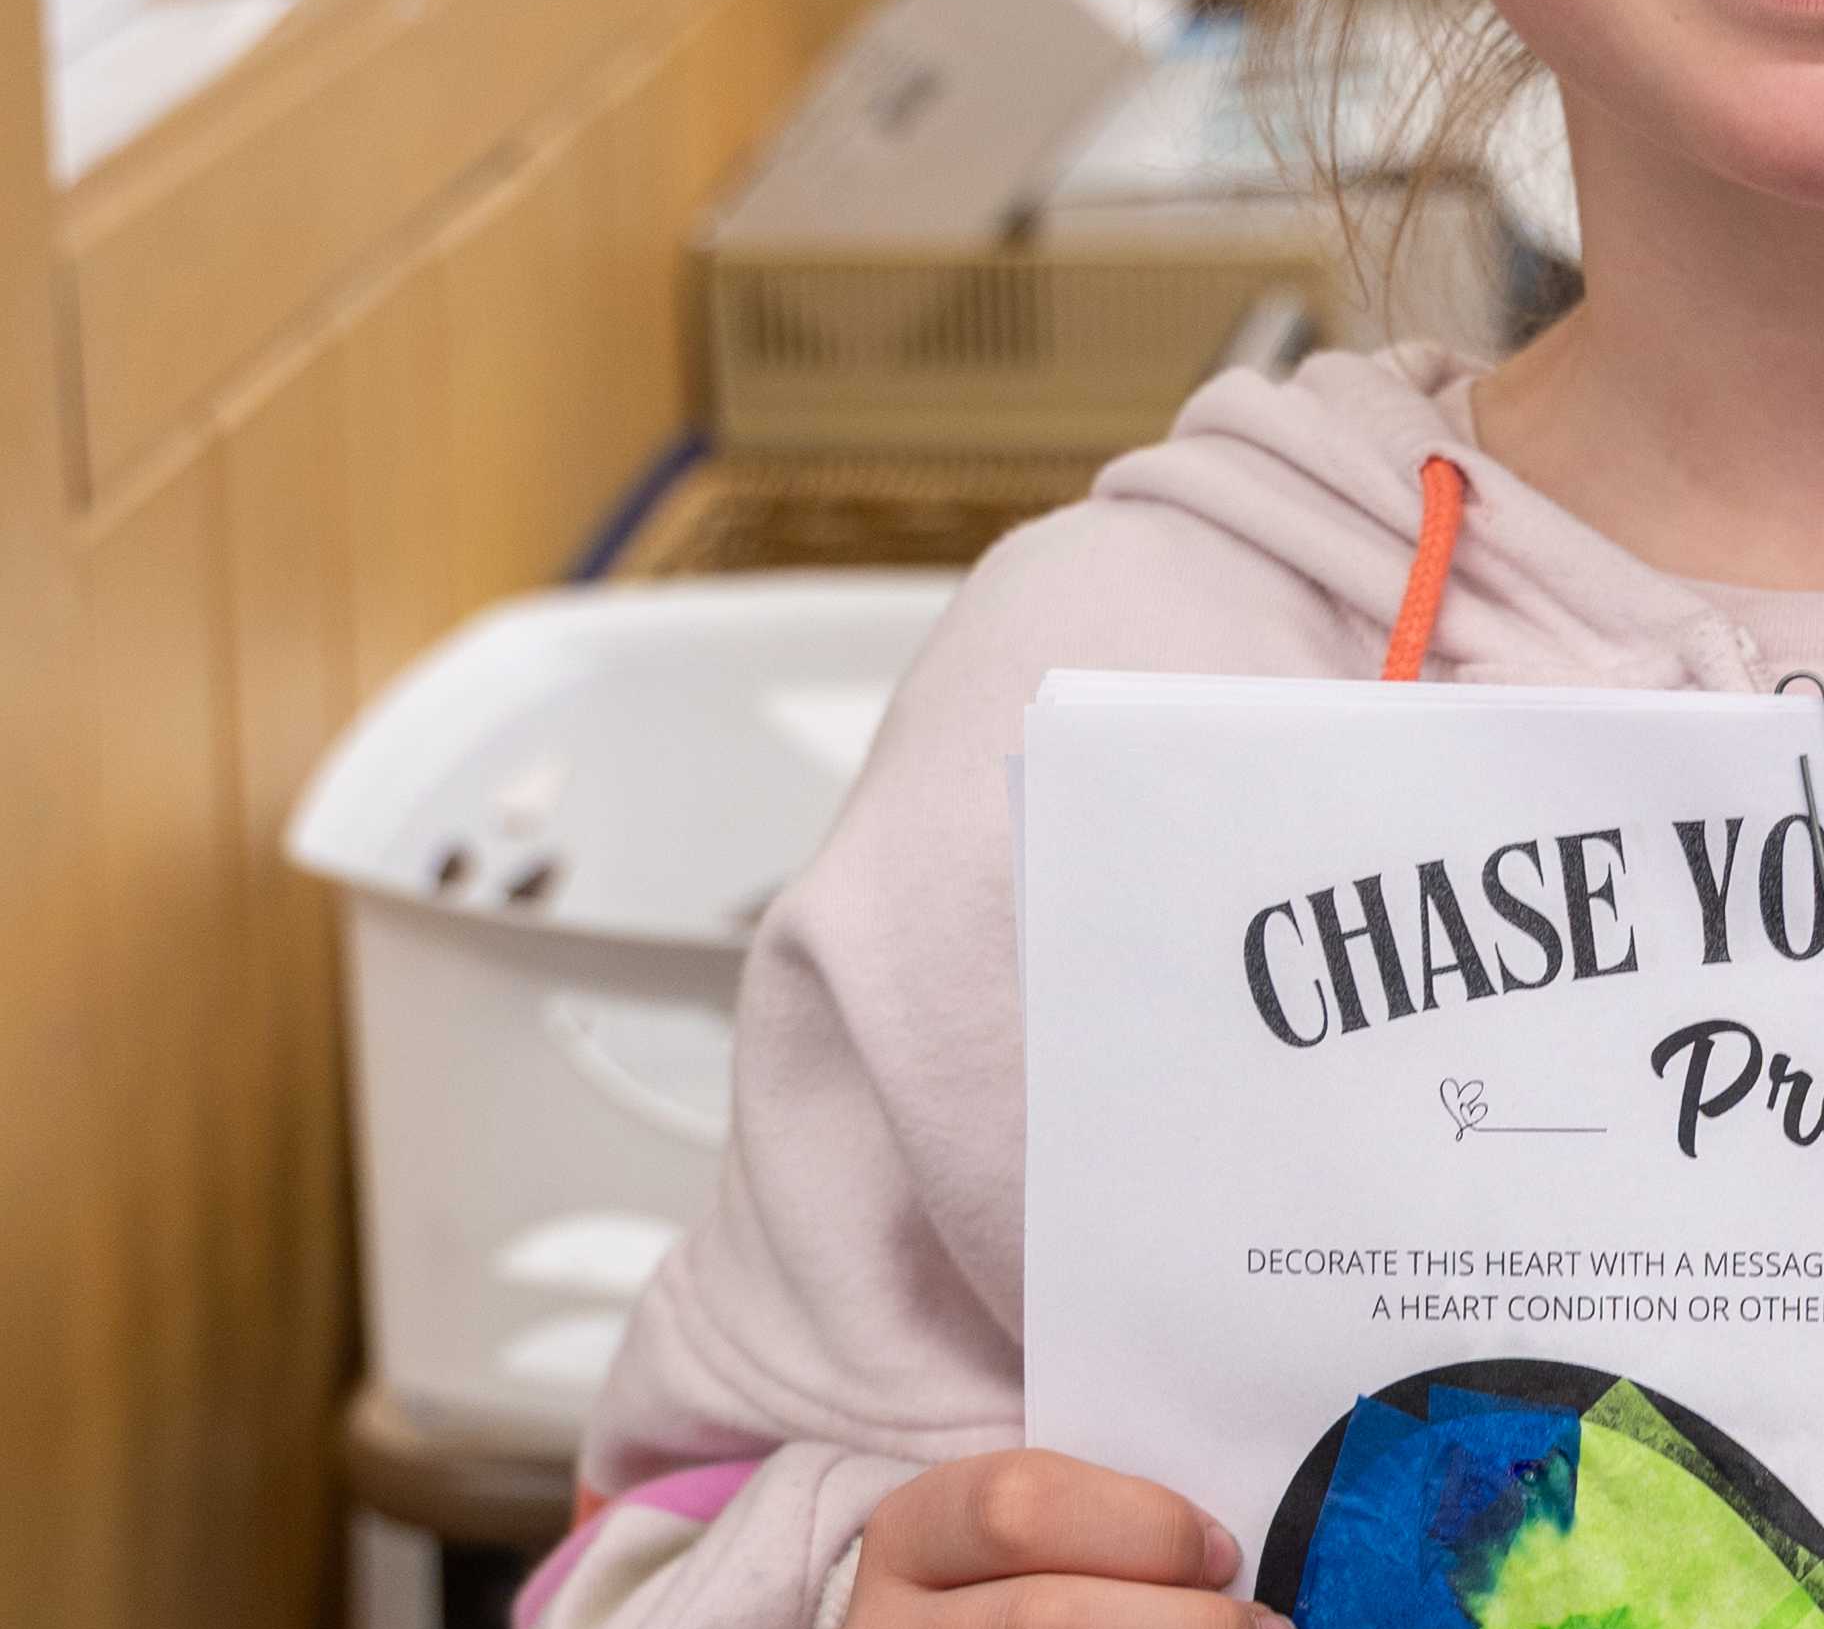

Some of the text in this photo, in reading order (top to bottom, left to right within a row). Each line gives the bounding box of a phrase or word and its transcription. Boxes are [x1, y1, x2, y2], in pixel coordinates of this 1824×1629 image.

[1241, 828, 1639, 1050] CHASE
[1247, 1248, 1398, 1276] DECORATE
[1407, 1250, 1474, 1277] THIS
[1485, 1251, 1582, 1277] HEART
[1589, 1251, 1665, 1277] WITH
[1674, 1251, 1694, 1277] A
[1371, 1294, 1391, 1320] A
[1401, 1294, 1499, 1321] HEART
[1507, 1295, 1677, 1322] CONDITION
[1688, 1295, 1730, 1322] OR
